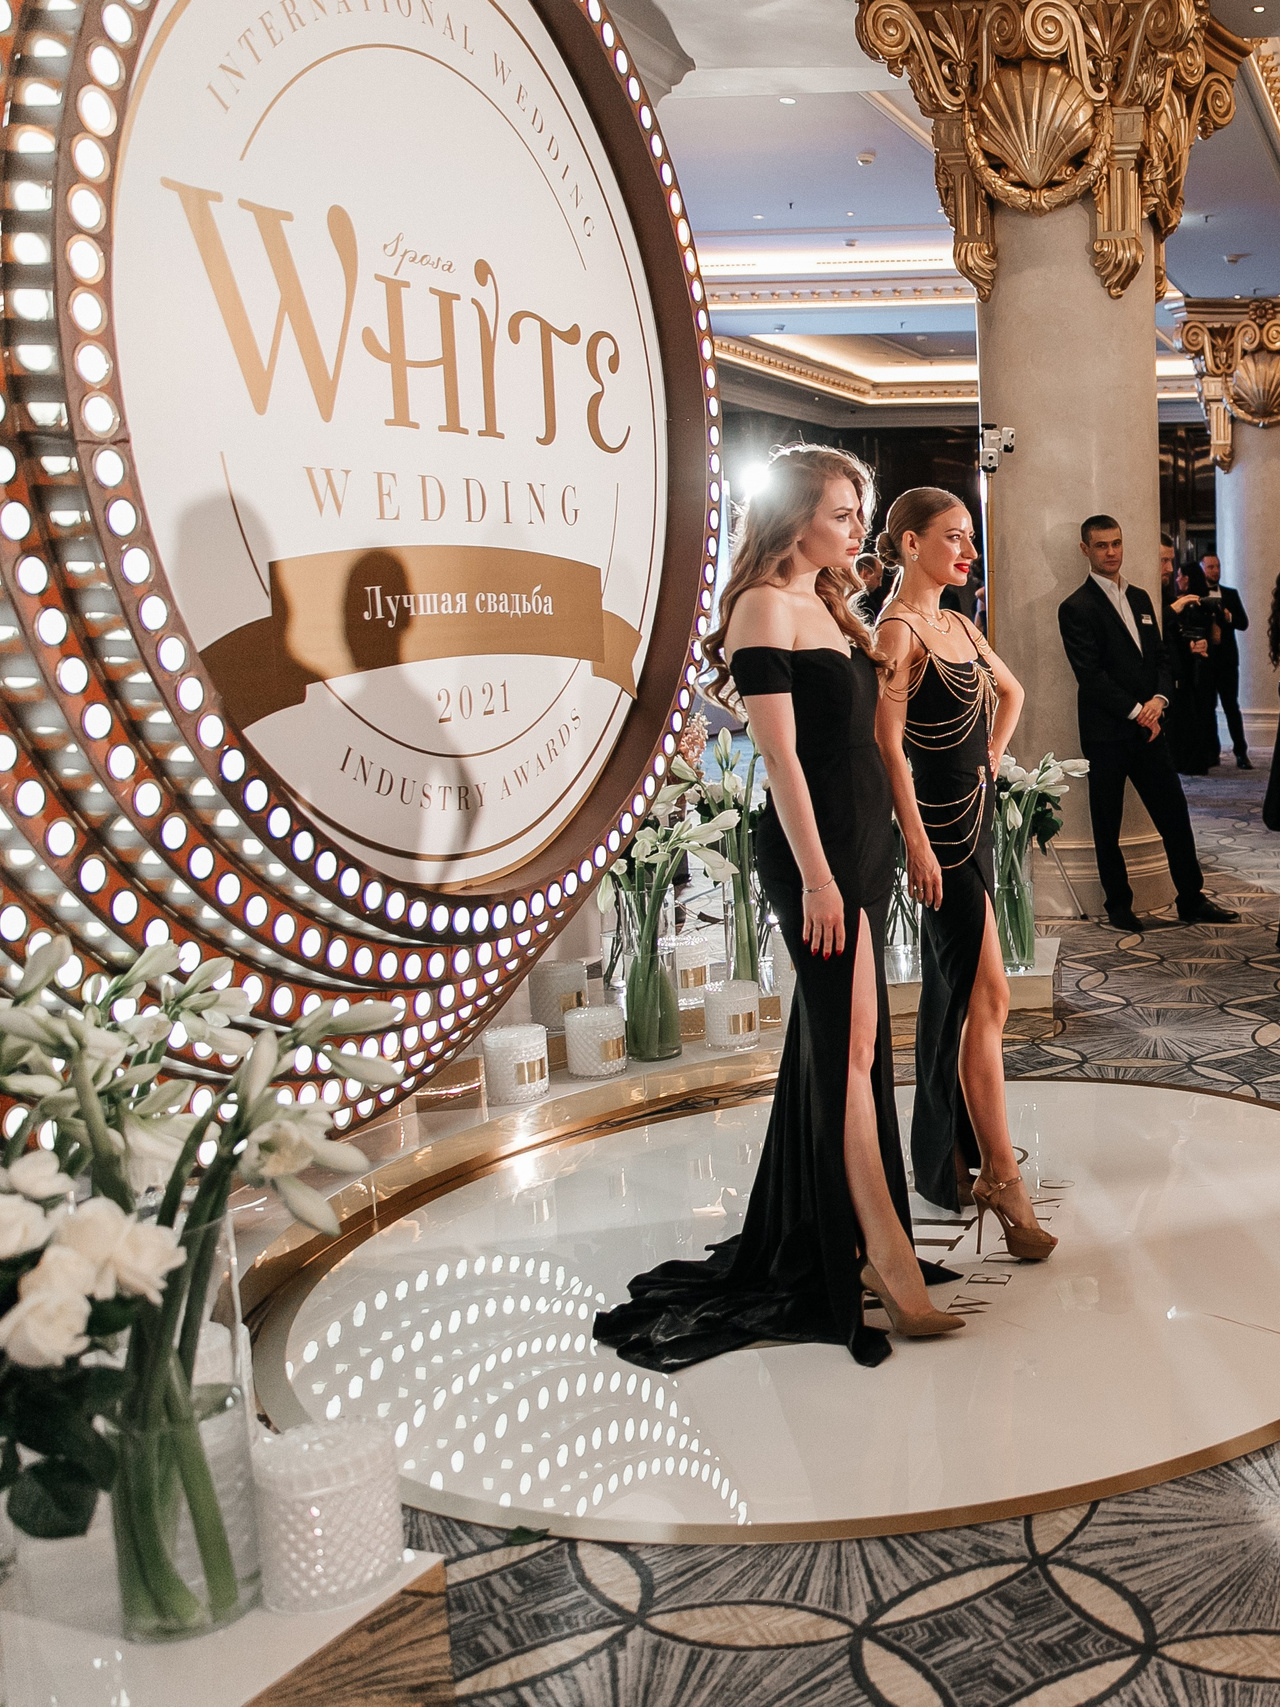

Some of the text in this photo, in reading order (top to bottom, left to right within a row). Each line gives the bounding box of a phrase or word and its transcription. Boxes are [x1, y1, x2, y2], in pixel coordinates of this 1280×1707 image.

[493, 50, 595, 237] WEDDING
[383, 232, 456, 276] Sposa
[304, 467, 580, 525] WEDDING
[363, 584, 554, 628] Лучшая свадьба
[437, 679, 511, 723] 2021
[339, 708, 582, 811] INDUSTRY AWARDS
